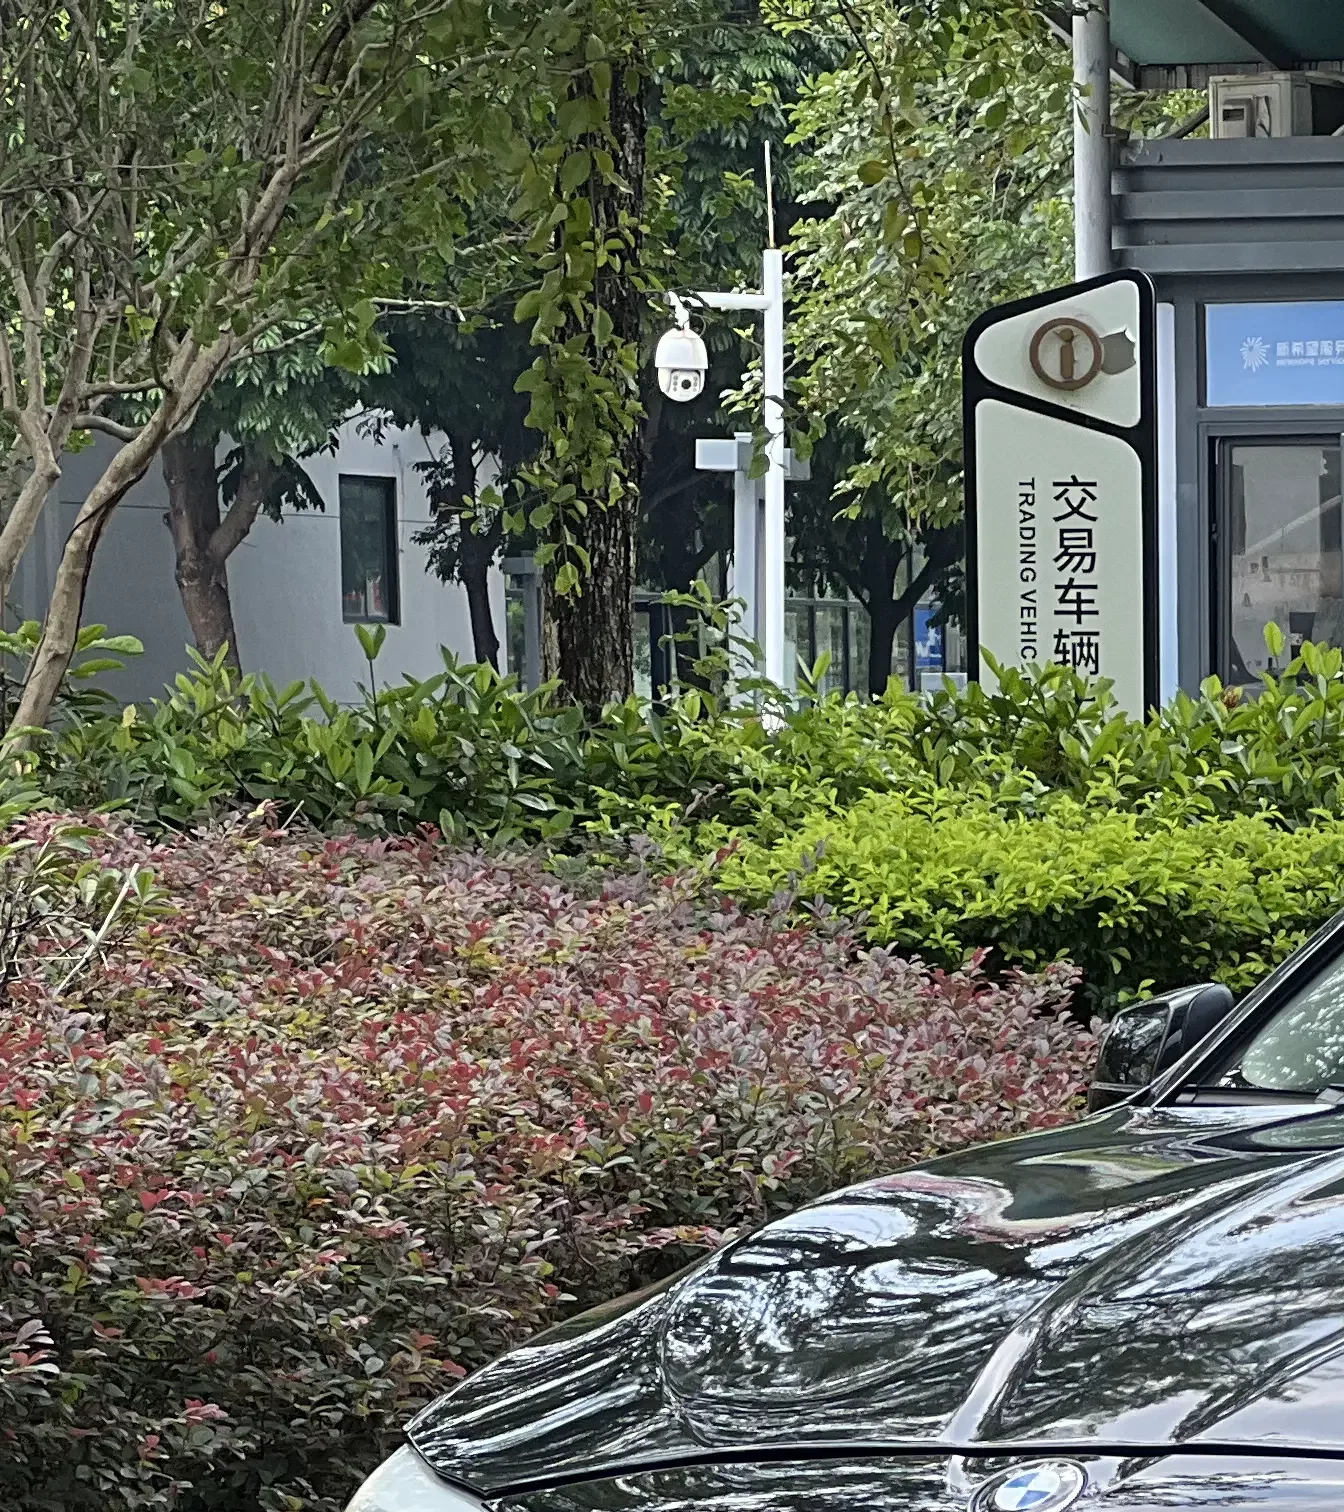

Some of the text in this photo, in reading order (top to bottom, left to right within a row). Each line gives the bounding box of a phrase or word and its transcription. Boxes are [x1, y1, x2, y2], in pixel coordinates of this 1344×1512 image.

[1018, 477, 1037, 686] TRADING VEHIC
[1052, 474, 1100, 703] 交易车辆
